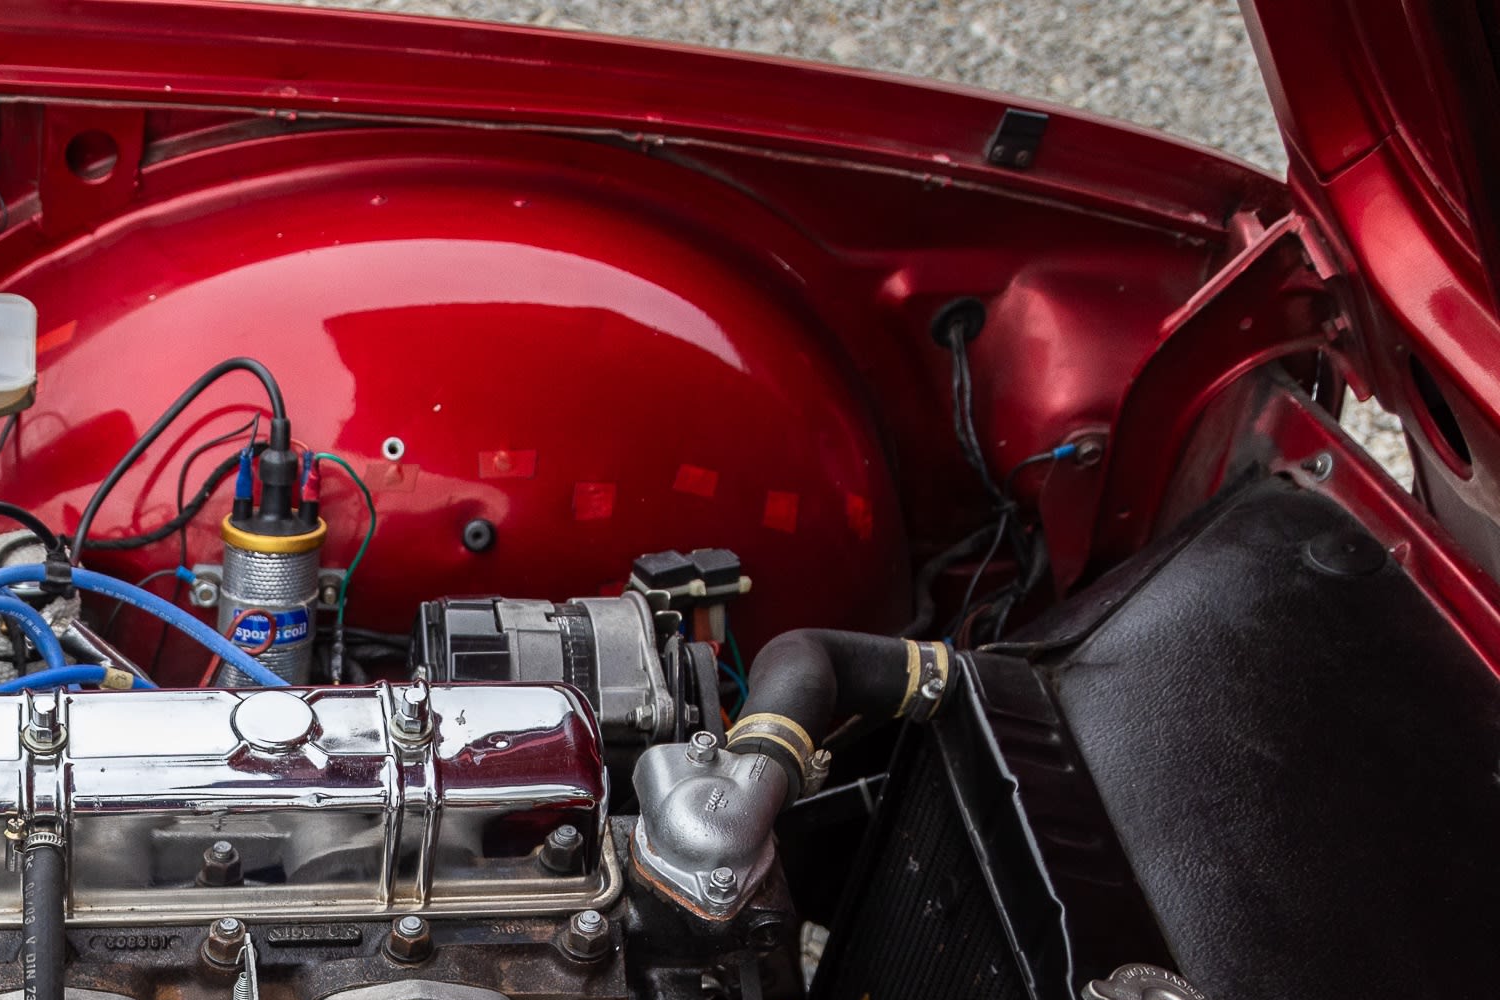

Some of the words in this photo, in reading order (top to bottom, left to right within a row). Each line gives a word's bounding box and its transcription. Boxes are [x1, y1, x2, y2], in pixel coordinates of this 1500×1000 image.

[236, 626, 281, 641] spors
[283, 622, 307, 639] coil
[26, 954, 38, 981] DIN
